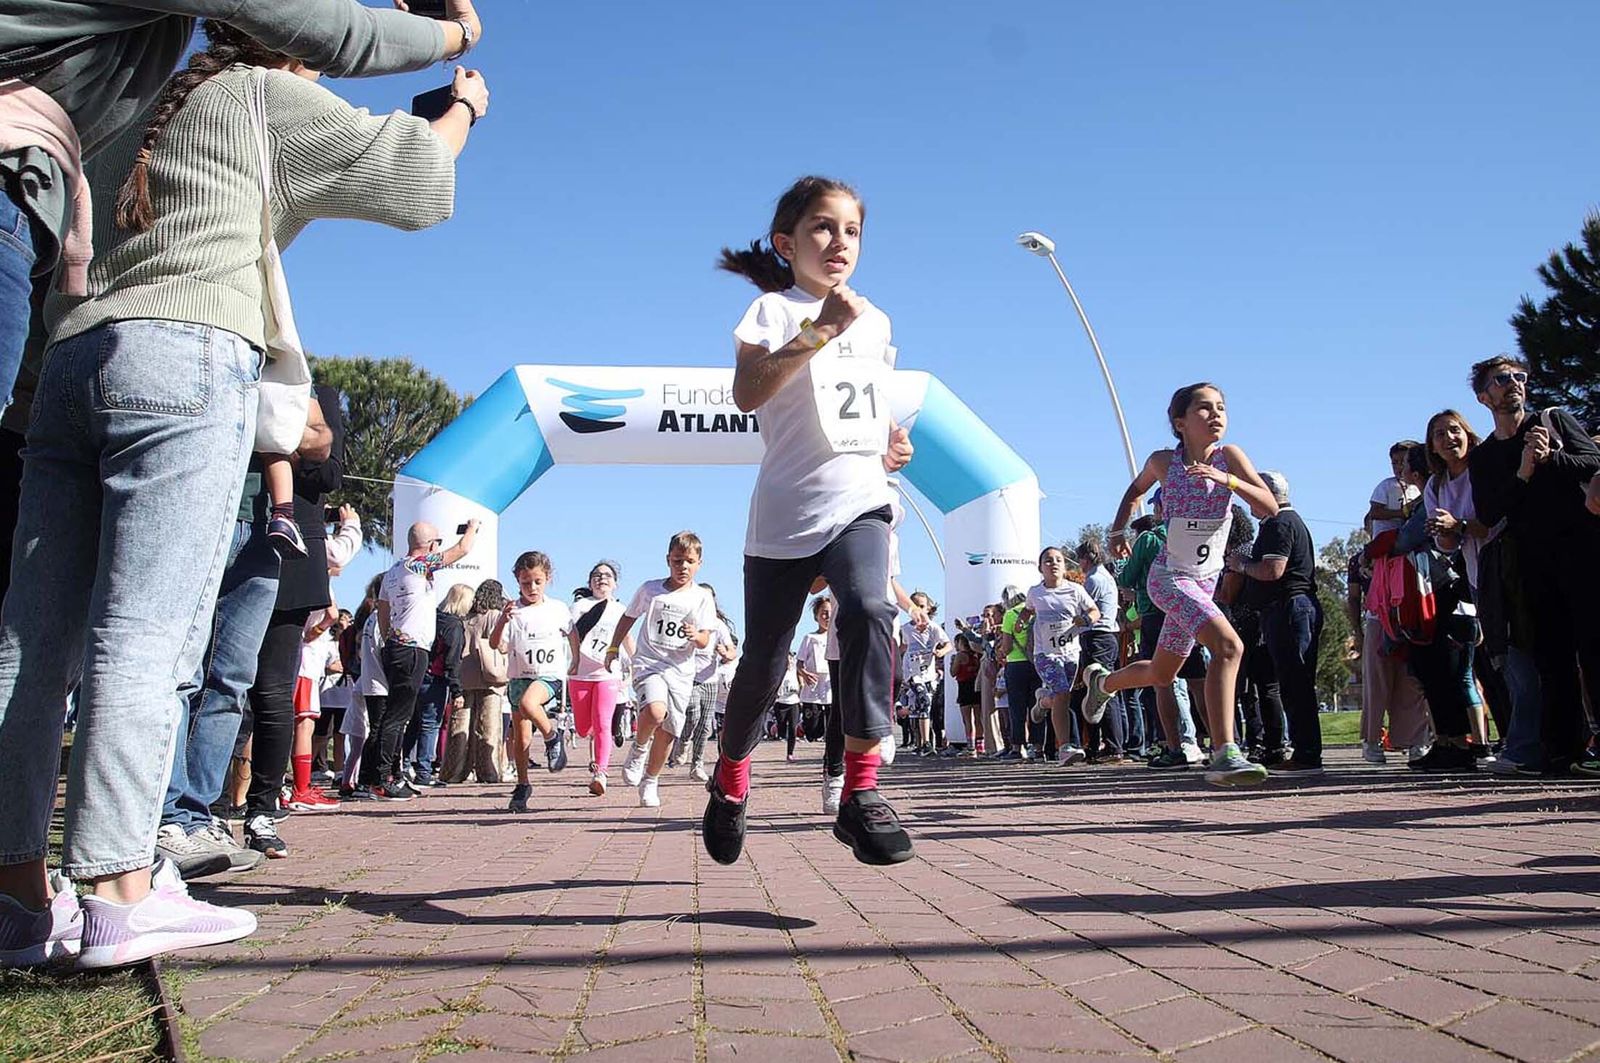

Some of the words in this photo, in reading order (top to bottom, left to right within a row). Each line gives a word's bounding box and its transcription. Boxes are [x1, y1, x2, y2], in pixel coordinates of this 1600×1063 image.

[835, 382, 877, 420] 21
[657, 409, 760, 433] ATLANT
[1196, 544, 1210, 566] 9
[656, 619, 688, 639] 186
[525, 648, 556, 665] 106
